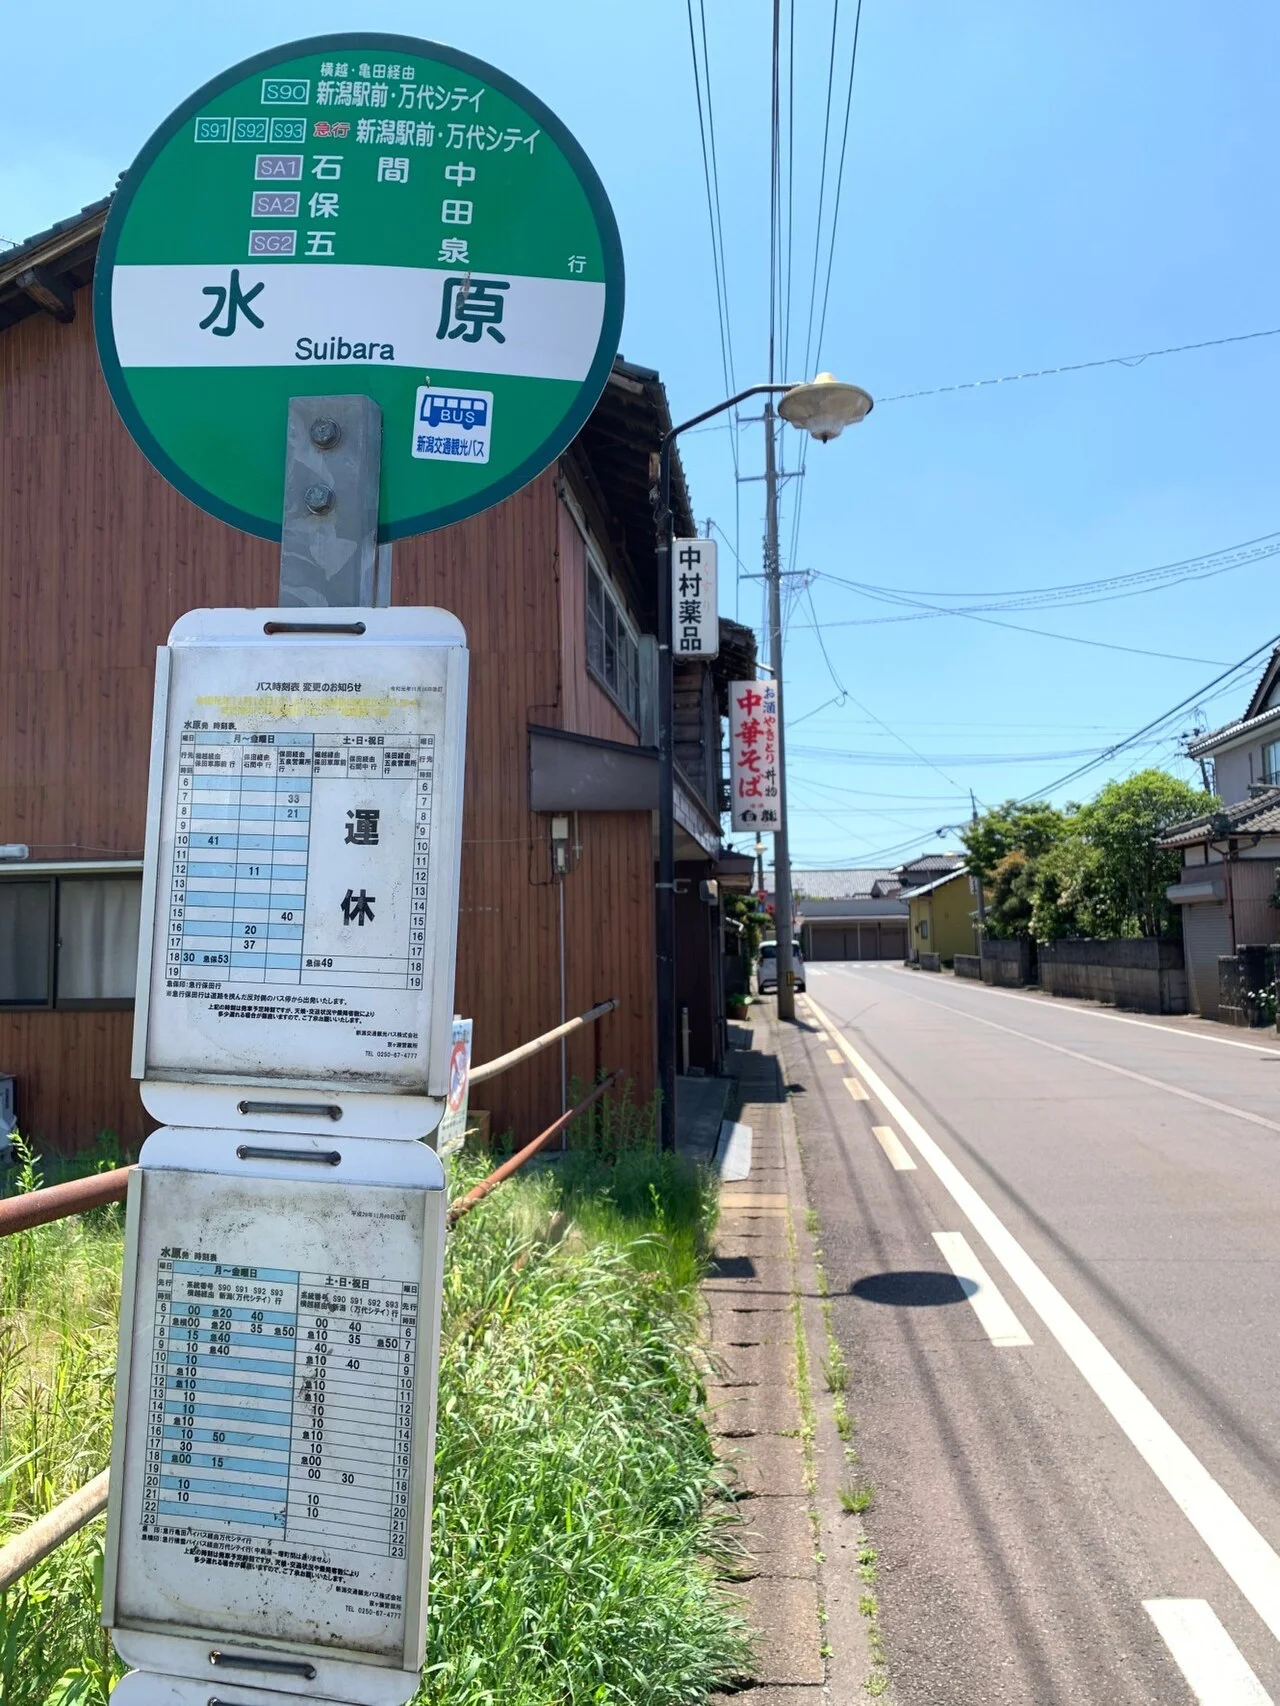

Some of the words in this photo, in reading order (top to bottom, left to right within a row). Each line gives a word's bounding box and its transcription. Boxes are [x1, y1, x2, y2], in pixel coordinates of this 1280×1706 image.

[320, 62, 415, 80] 横越・亀田経由
[267, 84, 306, 100] S90
[316, 80, 485, 113] 新潟駅前・万代シティ
[200, 122, 227, 138] S91
[236, 122, 265, 138] S92
[273, 122, 304, 138] S93
[312, 120, 351, 139] 急行
[355, 118, 540, 154] 新潟駅前・万代シティ
[260, 160, 297, 175] SA1
[257, 197, 295, 212] SA2
[253, 235, 293, 252] SG2
[567, 255, 587, 273] 行
[295, 336, 395, 360] Suibara
[440, 409, 475, 423] BUS
[416, 434, 485, 457] 新潟交通観光バス
[679, 546, 702, 651] 中村薬品
[256, 682, 300, 692] バス時刻表
[302, 682, 362, 692] 変更のお知らせ
[763, 687, 776, 714] お酒
[735, 688, 765, 798] 中華そば
[763, 716, 776, 764] やきとり
[288, 794, 300, 803] 33
[287, 809, 298, 818] 21
[178, 836, 188, 844] 10
[208, 836, 219, 845] 41
[176, 850, 186, 858] 11
[176, 864, 186, 874] 12
[249, 866, 260, 876] 11
[174, 879, 185, 888] 13
[174, 894, 184, 903] 14
[172, 908, 183, 918] 15
[280, 912, 294, 921] 40
[172, 923, 182, 932] 16
[244, 925, 257, 935] 20
[170, 938, 181, 946] 17
[243, 940, 256, 950] 37
[170, 953, 180, 962] 18
[183, 952, 196, 962] 30
[168, 967, 179, 976] 19
[365, 1050, 374, 1058] TEL
[218, 1284, 232, 1292] S90
[235, 1285, 248, 1294] S91
[253, 1286, 266, 1295] S92
[270, 1288, 284, 1297] S93
[333, 1294, 346, 1303] S90
[350, 1296, 363, 1305] S91
[368, 1298, 381, 1307] S92
[385, 1300, 399, 1309] S93
[188, 1305, 201, 1316] 00
[250, 1312, 264, 1322] 40
[316, 1318, 328, 1328] 00
[348, 1322, 362, 1332] 40
[187, 1330, 199, 1340] 15
[314, 1343, 327, 1354] 40
[250, 1324, 263, 1334] 35
[348, 1334, 361, 1344] 35
[186, 1342, 198, 1352] 10
[348, 1360, 360, 1370] 40
[155, 1352, 166, 1361] 10
[186, 1355, 198, 1365] 10
[315, 1368, 326, 1378] 10
[400, 1379, 412, 1388] 10
[154, 1364, 165, 1373] 11
[400, 1392, 411, 1401] 11
[154, 1376, 164, 1386] 12
[400, 1404, 410, 1414] 12
[152, 1389, 164, 1398] 13
[184, 1392, 196, 1402] 10
[312, 1406, 324, 1416] 10
[399, 1417, 410, 1426] 13
[152, 1402, 163, 1410] 14
[182, 1404, 194, 1414] 10
[312, 1418, 324, 1428] 10
[398, 1430, 410, 1440] 14
[152, 1414, 162, 1423] 15
[398, 1442, 409, 1452] 15
[150, 1426, 162, 1436] 16
[181, 1429, 194, 1439] 10
[212, 1432, 226, 1442] 50
[310, 1443, 322, 1454] 10
[398, 1456, 408, 1466] 16
[150, 1438, 160, 1448] 17
[180, 1442, 192, 1452] 30
[397, 1468, 408, 1478] 17
[149, 1451, 160, 1460] 18
[212, 1457, 224, 1468] 15
[308, 1468, 320, 1480] 00
[342, 1472, 354, 1484] 30
[396, 1481, 407, 1491] 18
[148, 1464, 159, 1472] 19
[396, 1494, 406, 1504] 19
[146, 1476, 158, 1486] 20
[178, 1479, 190, 1489] 10
[308, 1494, 320, 1505] 10
[394, 1508, 406, 1518] 20
[146, 1489, 157, 1498] 21
[178, 1492, 190, 1502] 10
[307, 1507, 319, 1518] 10
[393, 1520, 404, 1530] 21
[144, 1502, 156, 1511] 22
[392, 1534, 404, 1544] 22
[144, 1514, 156, 1524] 23
[392, 1546, 404, 1557] 23
[345, 1605, 355, 1613] TEL
